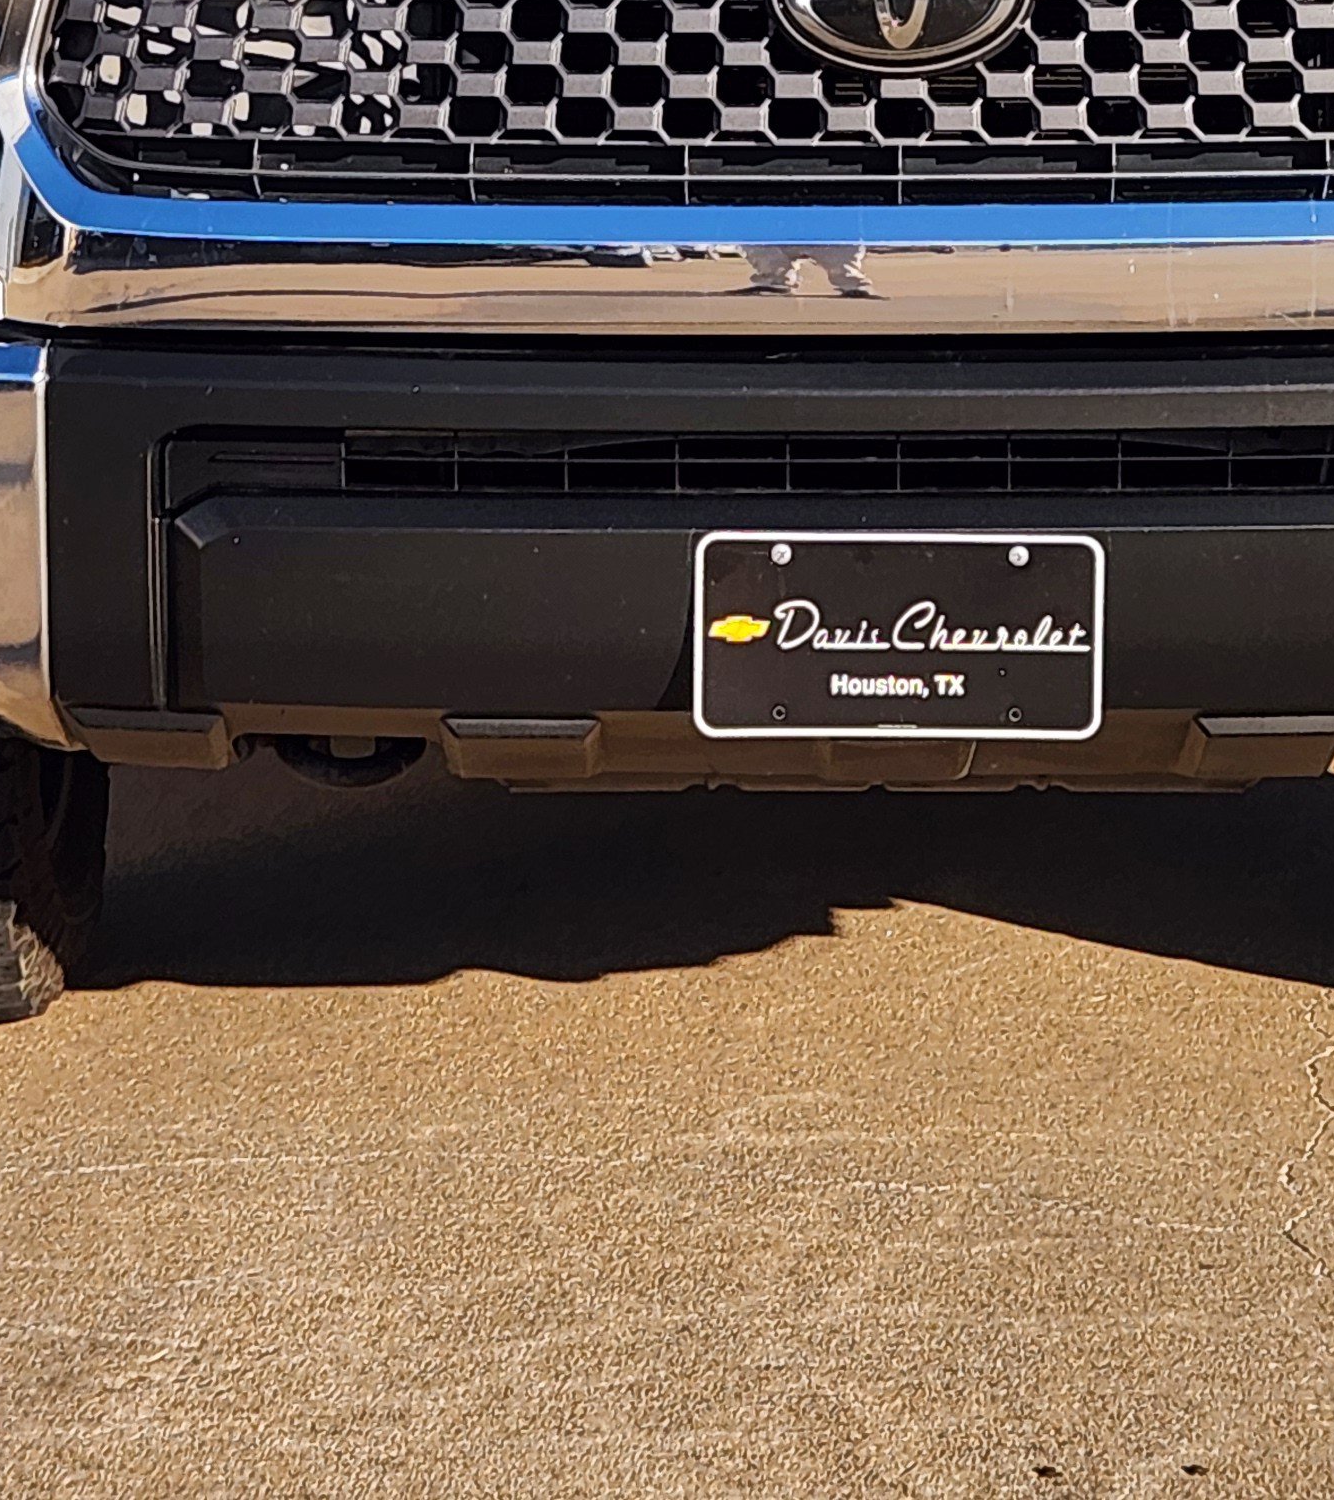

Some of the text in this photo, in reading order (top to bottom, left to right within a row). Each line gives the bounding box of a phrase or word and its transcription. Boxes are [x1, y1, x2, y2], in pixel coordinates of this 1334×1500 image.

[773, 600, 1092, 652] Davis Chevrolet
[830, 674, 965, 699] Houston, TX
